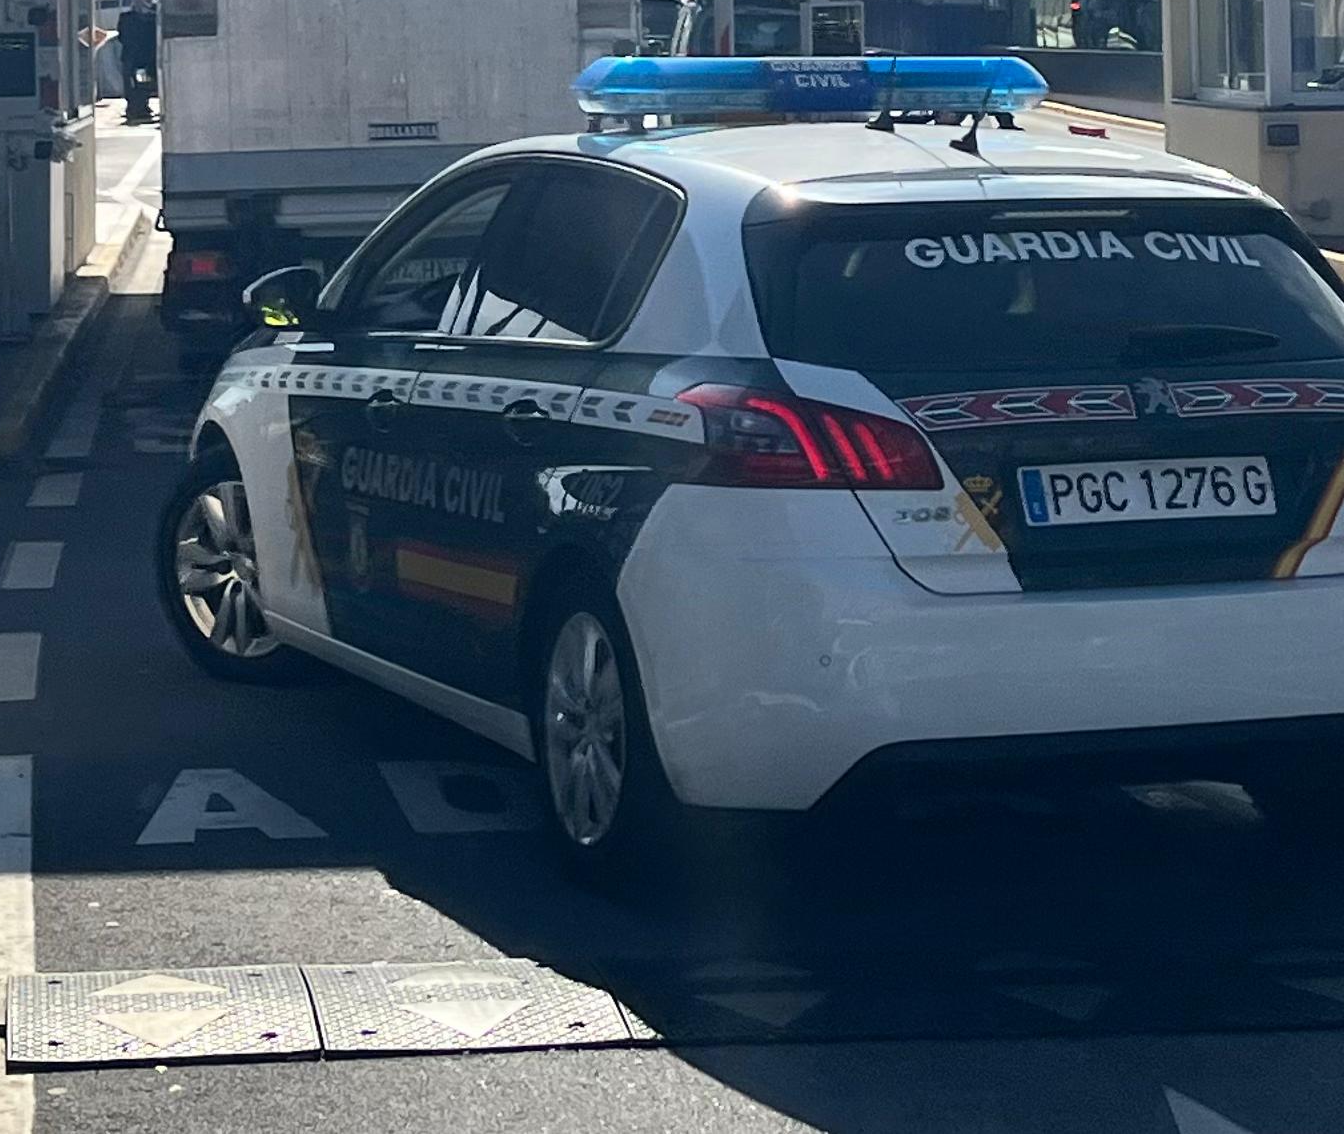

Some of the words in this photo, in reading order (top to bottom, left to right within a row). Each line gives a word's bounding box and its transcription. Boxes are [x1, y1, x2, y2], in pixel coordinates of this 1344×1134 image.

[795, 74, 851, 88] CIVIL
[904, 231, 1135, 268] GUARDIA
[1143, 231, 1261, 267] CIVIL
[342, 446, 436, 509] GUARDIA
[444, 466, 505, 524] CIVIL
